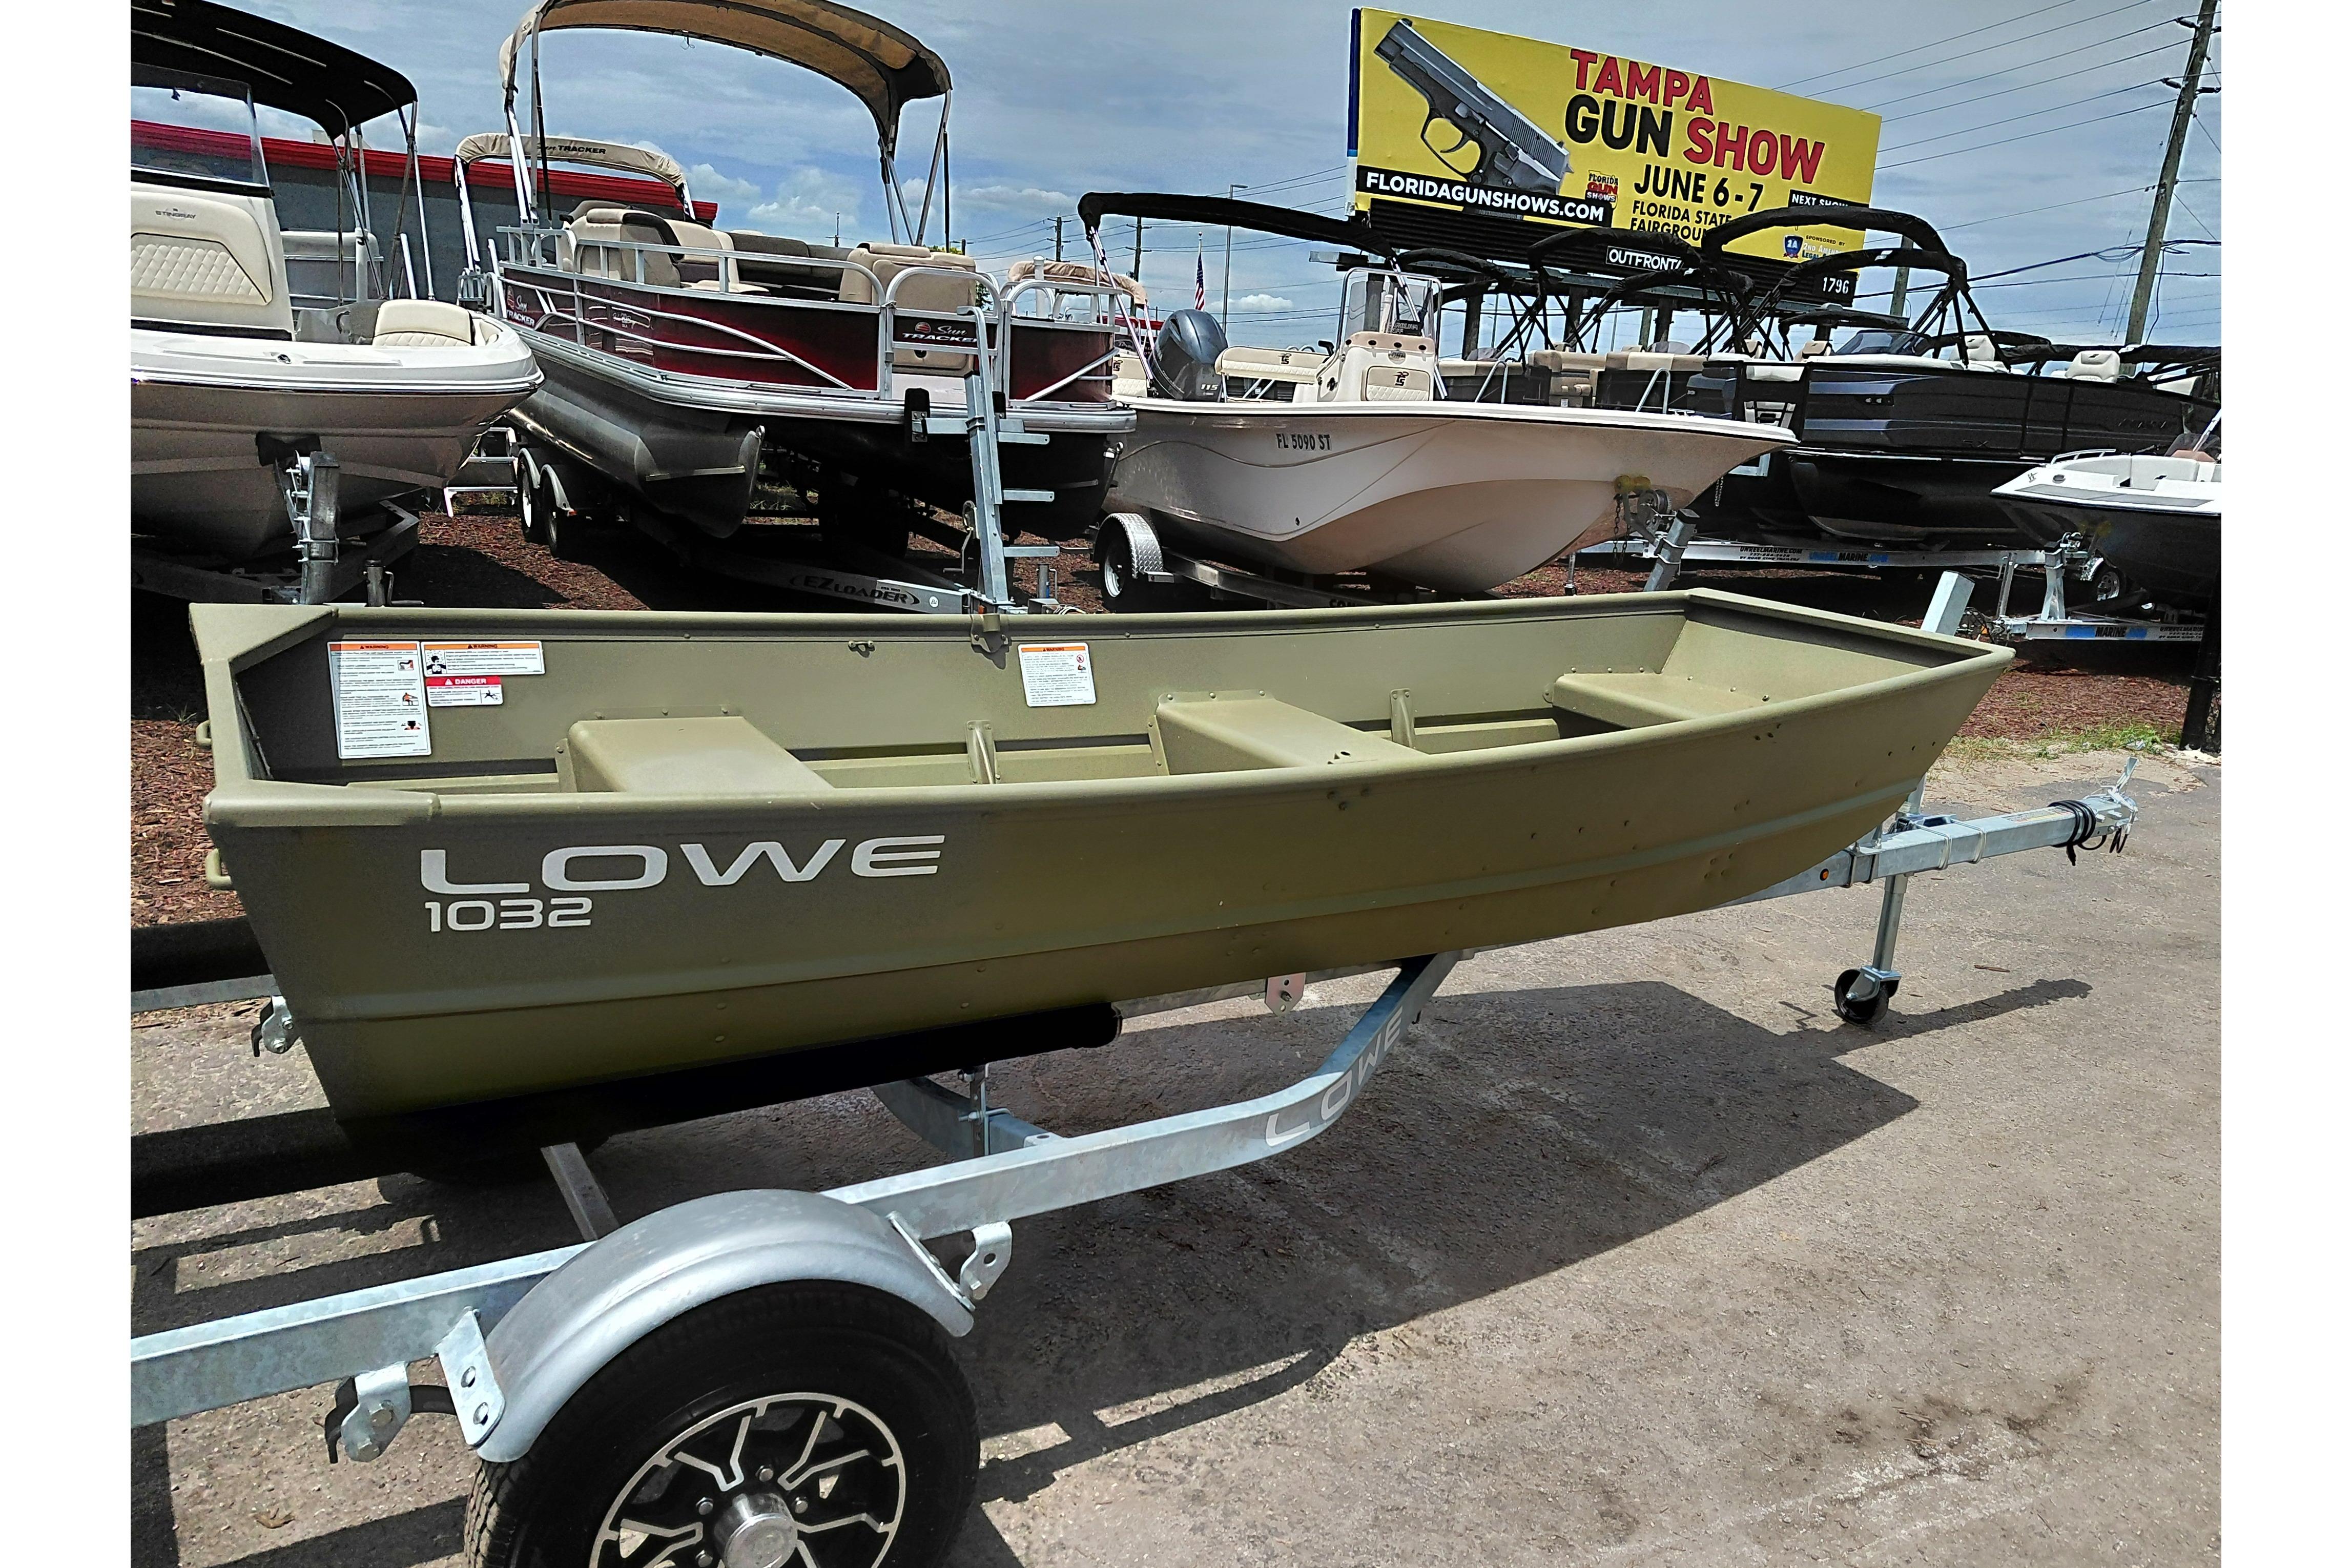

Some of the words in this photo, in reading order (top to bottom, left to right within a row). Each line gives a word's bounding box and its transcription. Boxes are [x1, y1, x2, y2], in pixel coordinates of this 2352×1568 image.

[1571, 48, 1714, 115] TAMPA
[1565, 94, 1673, 157] GUN
[1683, 117, 1825, 184] SHOW
[558, 145, 606, 154] TRACKER
[1588, 173, 1618, 185] FLORIDA
[1634, 164, 1706, 203] JUNE
[1366, 171, 1604, 222] FLORIDAGUNSHOWS.COM
[1587, 181, 1618, 195] GUN
[1791, 194, 1817, 206] NEXT
[1633, 200, 1690, 222] FLORIDA
[1631, 218, 1706, 241] FAIRGROU
[1806, 235, 1836, 244] SPONSORED
[1823, 277, 1850, 294] 1796
[933, 325, 967, 335] Sun
[1276, 433, 1289, 448] FL
[1291, 434, 1315, 450] 5090
[1318, 434, 1331, 450] ST
[1838, 552, 1868, 562] MARINE
[2095, 627, 2127, 637] MARINE
[420, 835, 945, 894] LOWE
[424, 897, 592, 933] 1032
[1266, 1005, 1402, 1147] LOWE
